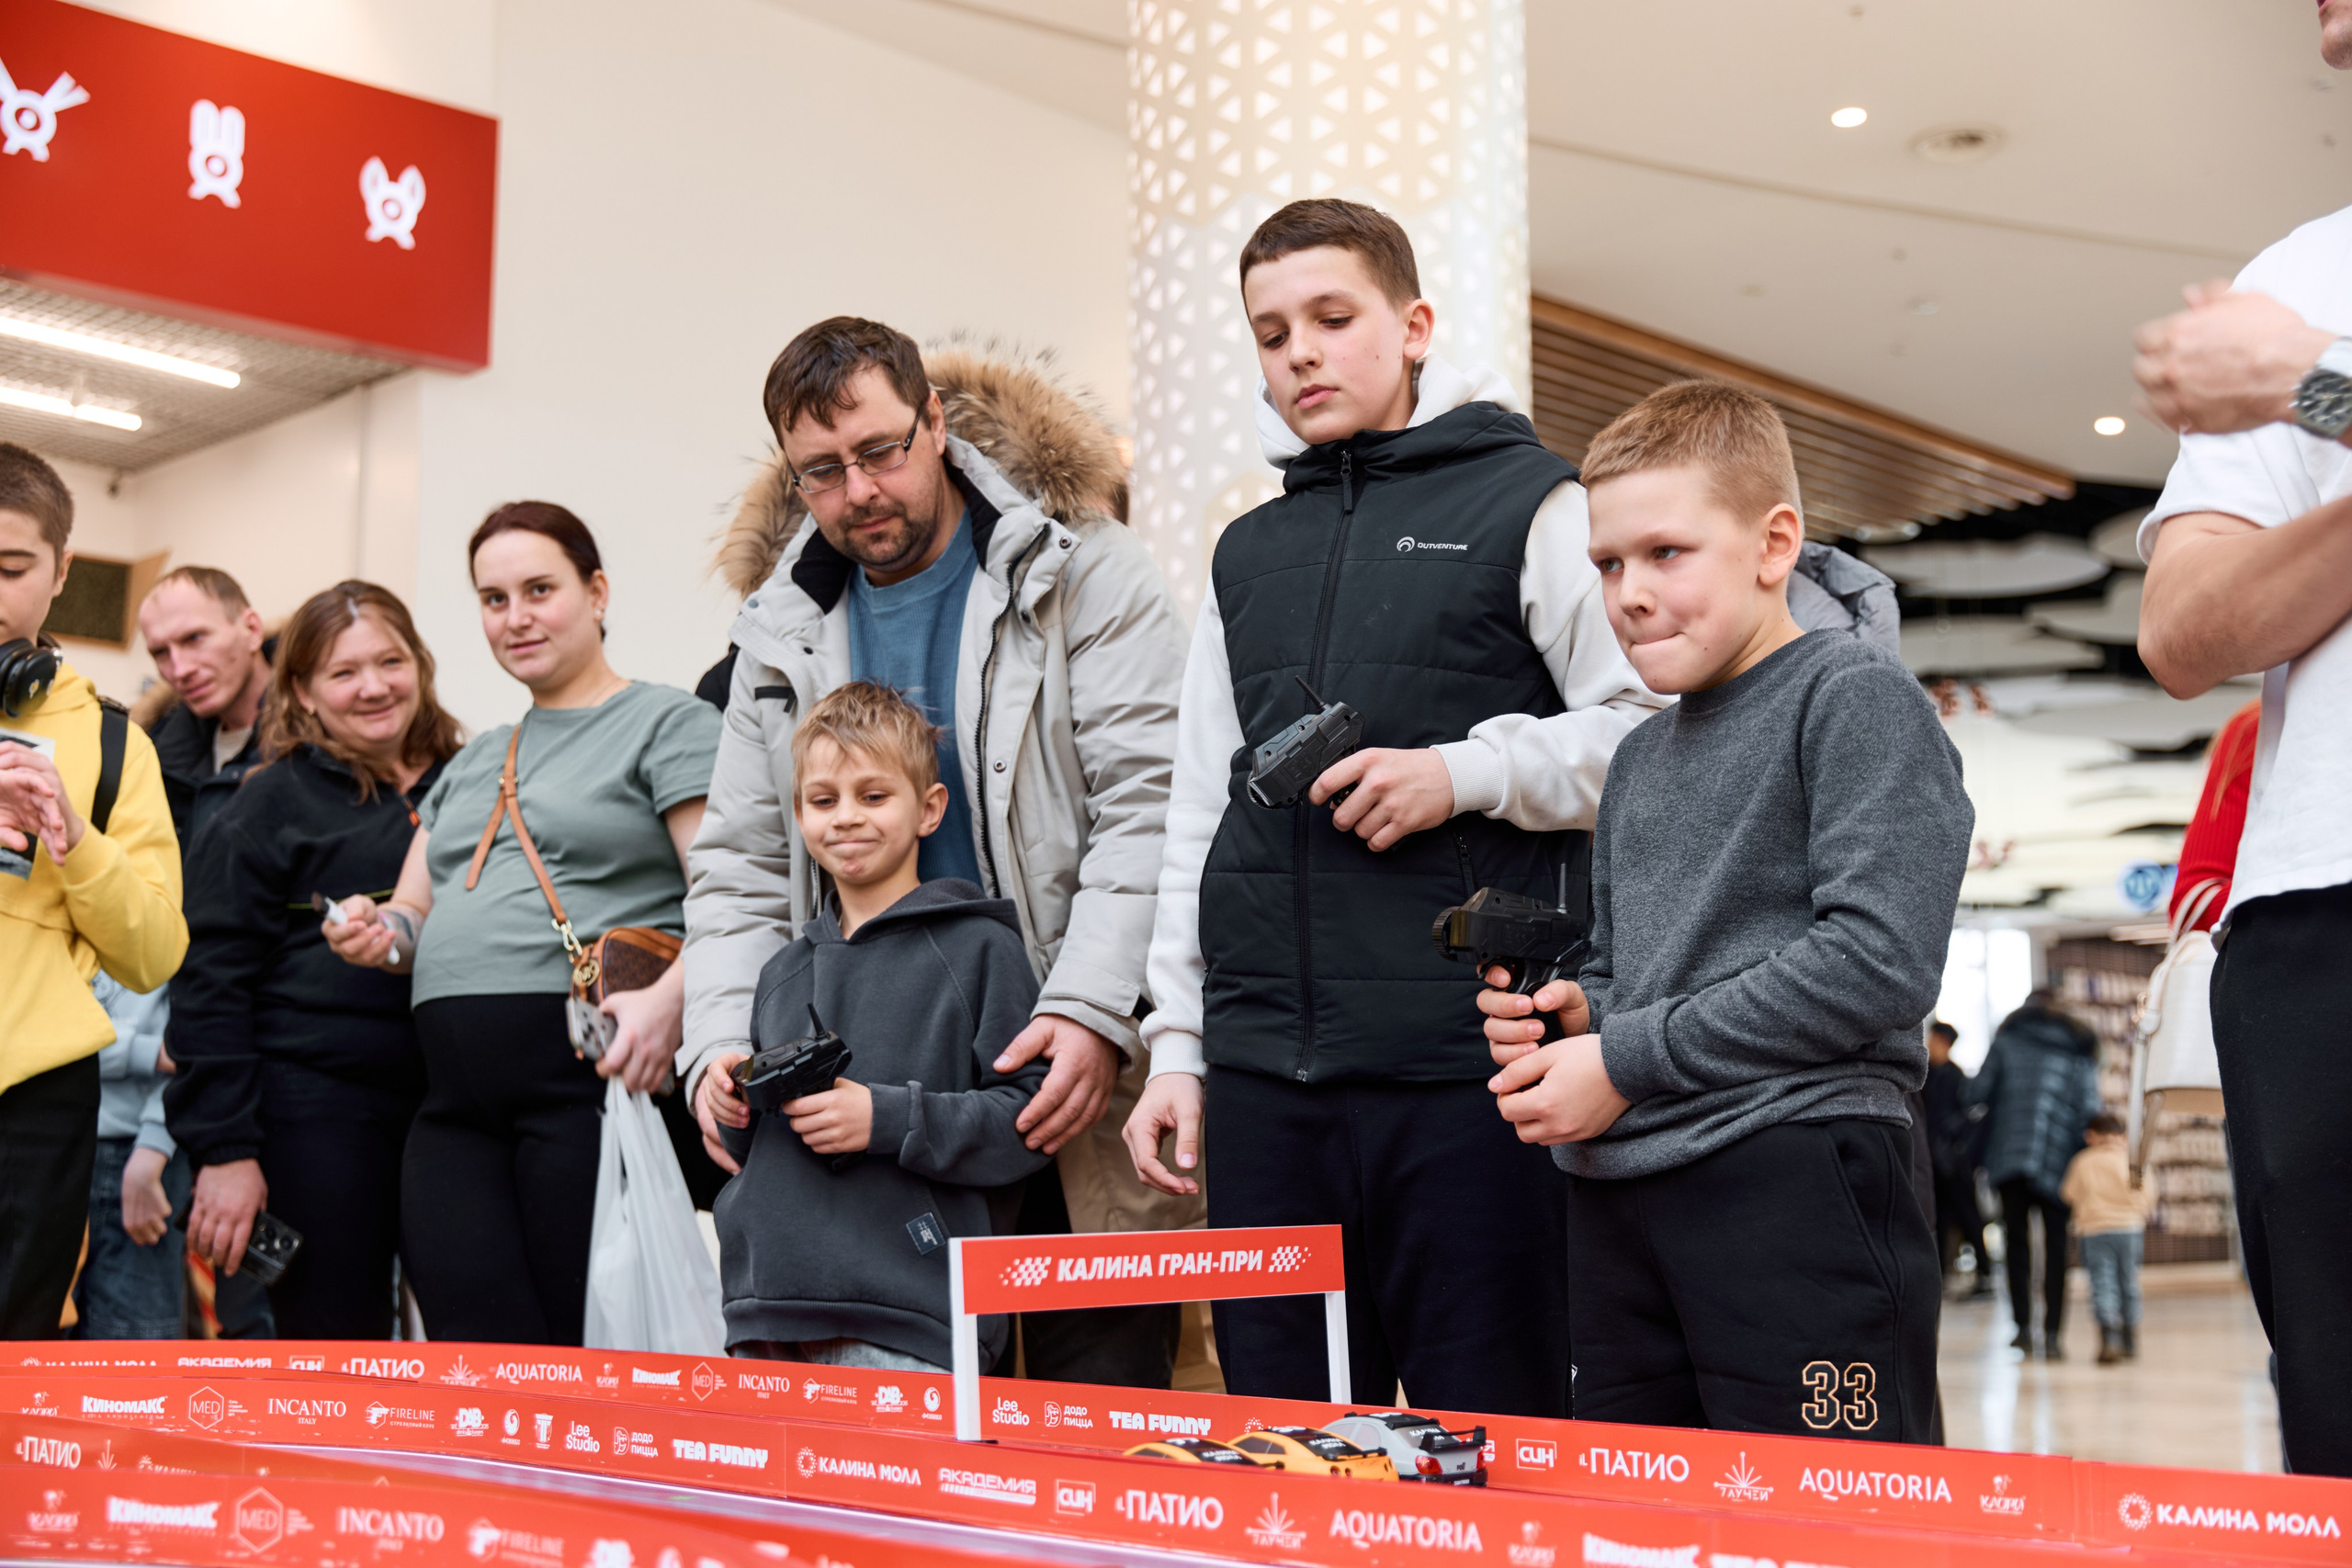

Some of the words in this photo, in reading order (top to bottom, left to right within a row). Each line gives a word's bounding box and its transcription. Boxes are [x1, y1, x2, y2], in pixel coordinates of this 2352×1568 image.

[1417, 542, 1469, 551] OUTVENTURE
[1057, 1255, 1153, 1281] КАЛИНА
[1159, 1249, 1263, 1277] ГРАН-ПРИ
[177, 1357, 272, 1368] АКАДЕМИЯ
[350, 1358, 425, 1379] ПАТИО
[495, 1362, 583, 1384] AQUATORIA
[632, 1367, 682, 1386] КИНОМАКС
[738, 1373, 790, 1393] INCANTO
[820, 1383, 857, 1398] FIRELINE
[1802, 1360, 1878, 1430] 33
[82, 1395, 165, 1414] КИНОМАКС
[192, 1401, 220, 1415] MED
[268, 1398, 347, 1417] INCANTO
[998, 1396, 1018, 1411] Lee
[1063, 1405, 1088, 1416] ДОДО
[390, 1407, 435, 1421] FIRELINE
[992, 1408, 1030, 1426] Studio
[1064, 1416, 1093, 1428] ПИЦЦА
[1109, 1411, 1145, 1430] TEA
[1148, 1414, 1212, 1436] FUNNY
[571, 1420, 590, 1436] Lee
[631, 1431, 653, 1443] ДОДО
[24, 1436, 81, 1468] ПАТИО
[566, 1435, 600, 1453] Studio
[631, 1445, 659, 1458] ПИЦЦА
[673, 1439, 707, 1461] TEA
[709, 1442, 769, 1468] FUNNY
[819, 1456, 876, 1480] КАЛИНА
[879, 1464, 922, 1486] МОЛЛ
[1590, 1447, 1690, 1483] ПАТИО
[939, 1468, 1036, 1495] АКАДЕМИЯ
[1799, 1467, 1952, 1503] AQUATORIA
[107, 1495, 220, 1529] КИНОМАКС
[241, 1508, 279, 1530] MED
[1126, 1489, 1224, 1529] ПАТИО
[337, 1506, 445, 1542] INCANTO
[1330, 1509, 1484, 1551] AQUATORIA
[2156, 1503, 2260, 1532] КАЛИНА
[2266, 1511, 2342, 1540] МОЛЛ
